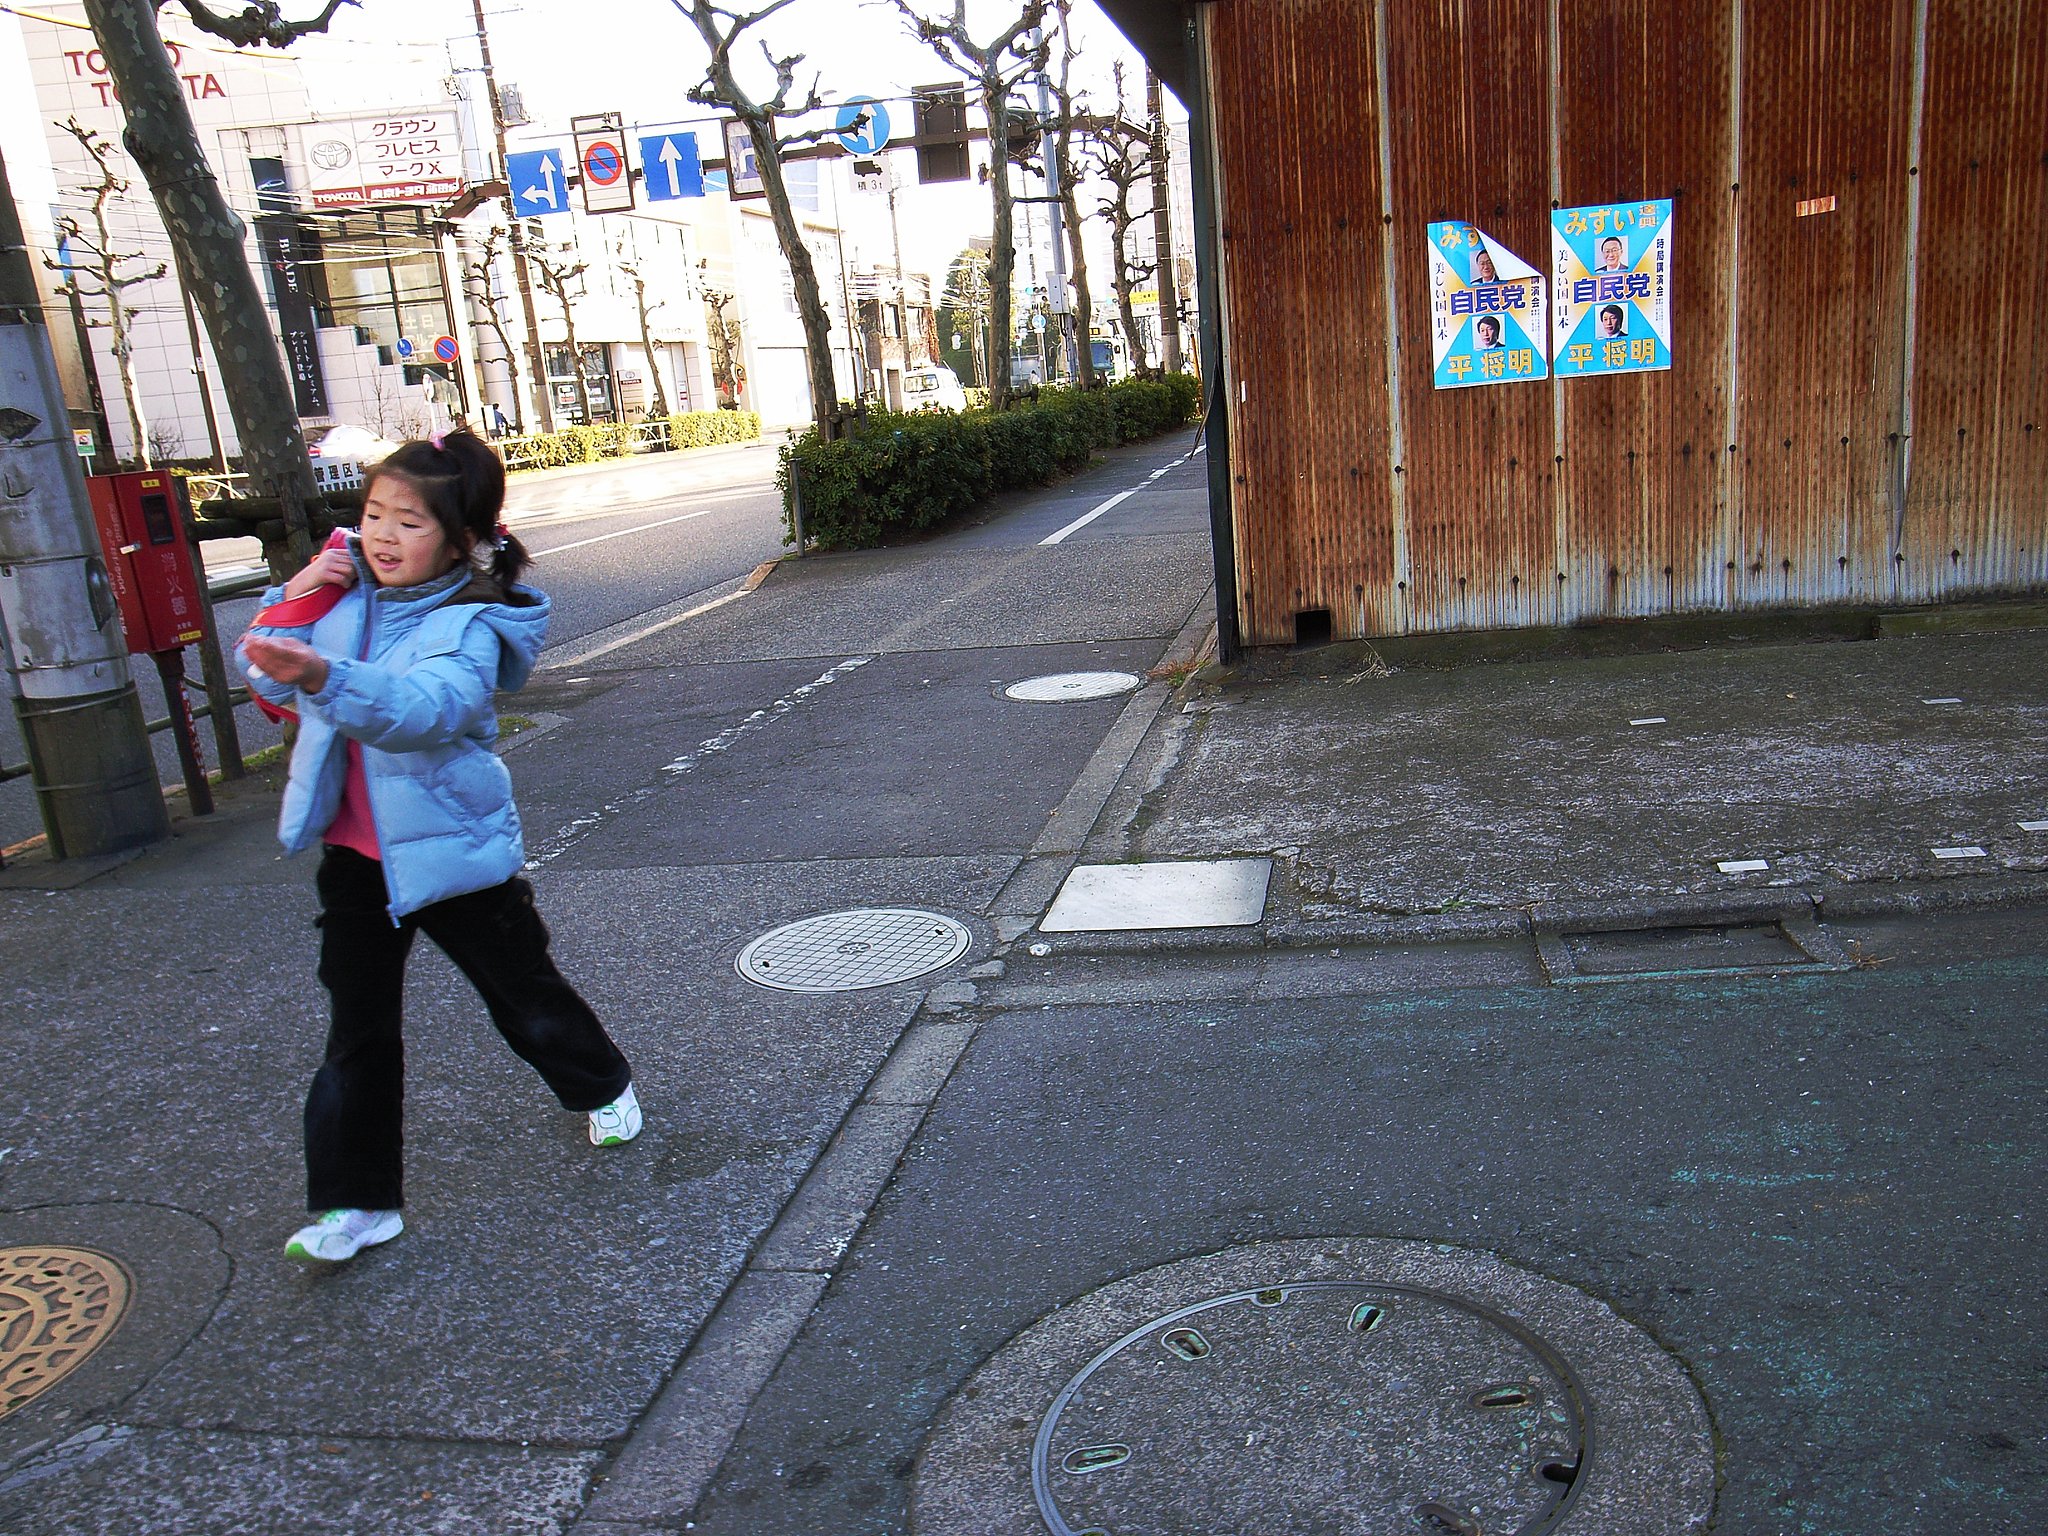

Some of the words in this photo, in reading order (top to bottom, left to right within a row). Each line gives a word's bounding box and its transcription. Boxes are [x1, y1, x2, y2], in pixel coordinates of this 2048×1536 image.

[64, 44, 181, 76] TOO
[91, 73, 227, 107] TTA
[373, 119, 436, 137] クラウン
[378, 160, 443, 177] マークX
[317, 191, 363, 204] TOYOTA
[1564, 207, 1635, 237] みずい
[279, 238, 299, 294] BLADE
[1655, 238, 1665, 297] 時局講演会
[1450, 284, 1526, 316] 自民党
[1572, 273, 1651, 304] 自民党
[634, 405, 646, 415] IN
[160, 551, 188, 616] 消火器
